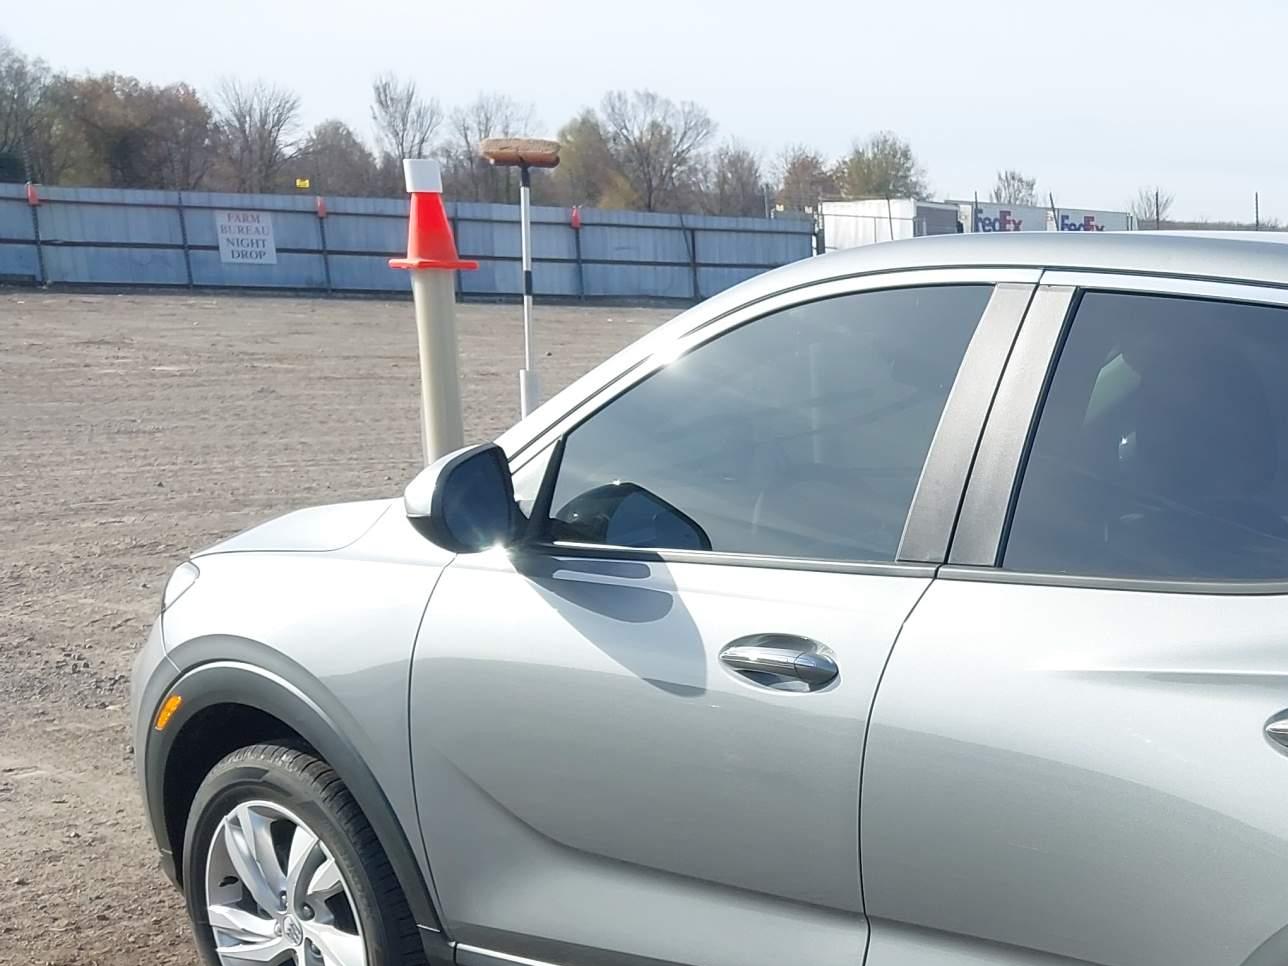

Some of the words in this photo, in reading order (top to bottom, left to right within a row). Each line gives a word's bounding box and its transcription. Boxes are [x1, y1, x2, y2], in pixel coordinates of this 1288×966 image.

[227, 212, 261, 223] FARM
[974, 208, 1023, 233] FedEx
[220, 224, 270, 236] BUREAU
[226, 237, 267, 249] NIGHT
[231, 249, 267, 261] DROP
